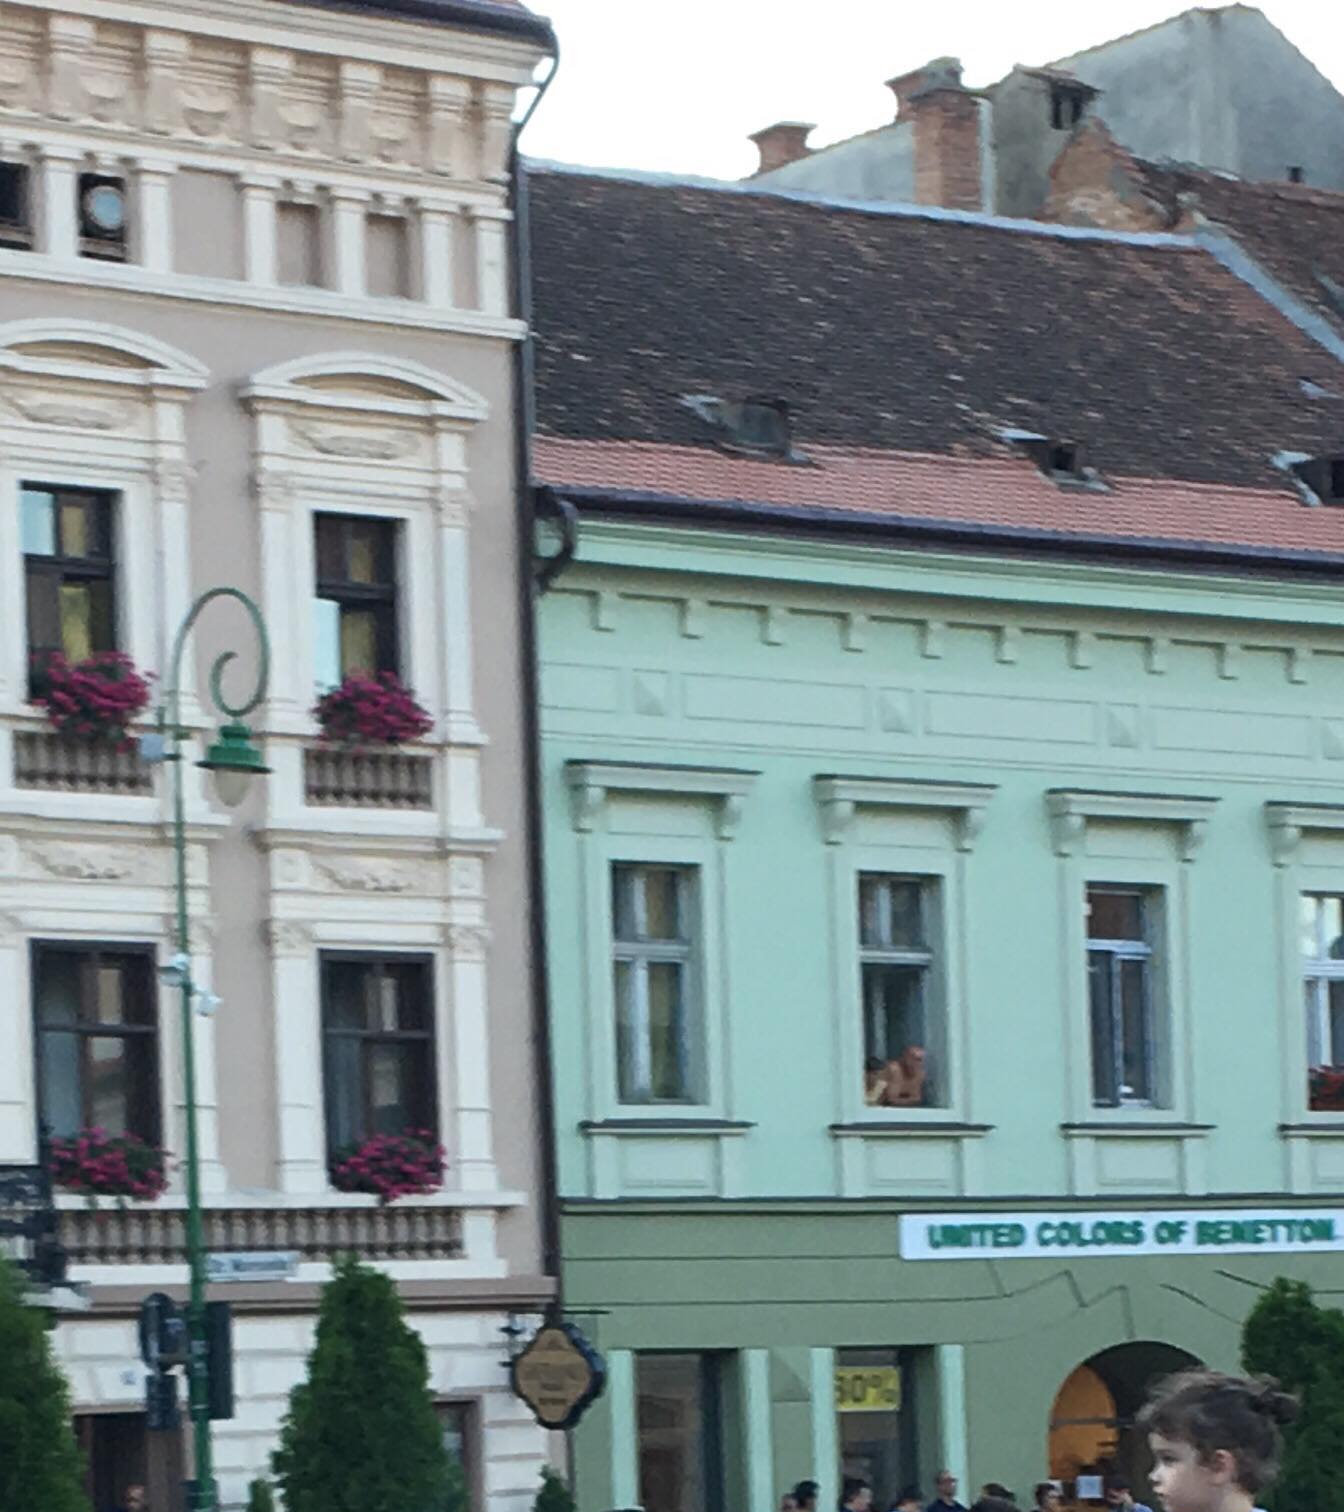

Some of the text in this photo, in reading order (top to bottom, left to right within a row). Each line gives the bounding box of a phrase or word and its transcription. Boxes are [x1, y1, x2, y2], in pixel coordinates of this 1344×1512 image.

[927, 1222, 1026, 1248] UNITED
[1037, 1220, 1144, 1246] COLORS
[1154, 1219, 1188, 1244] OF
